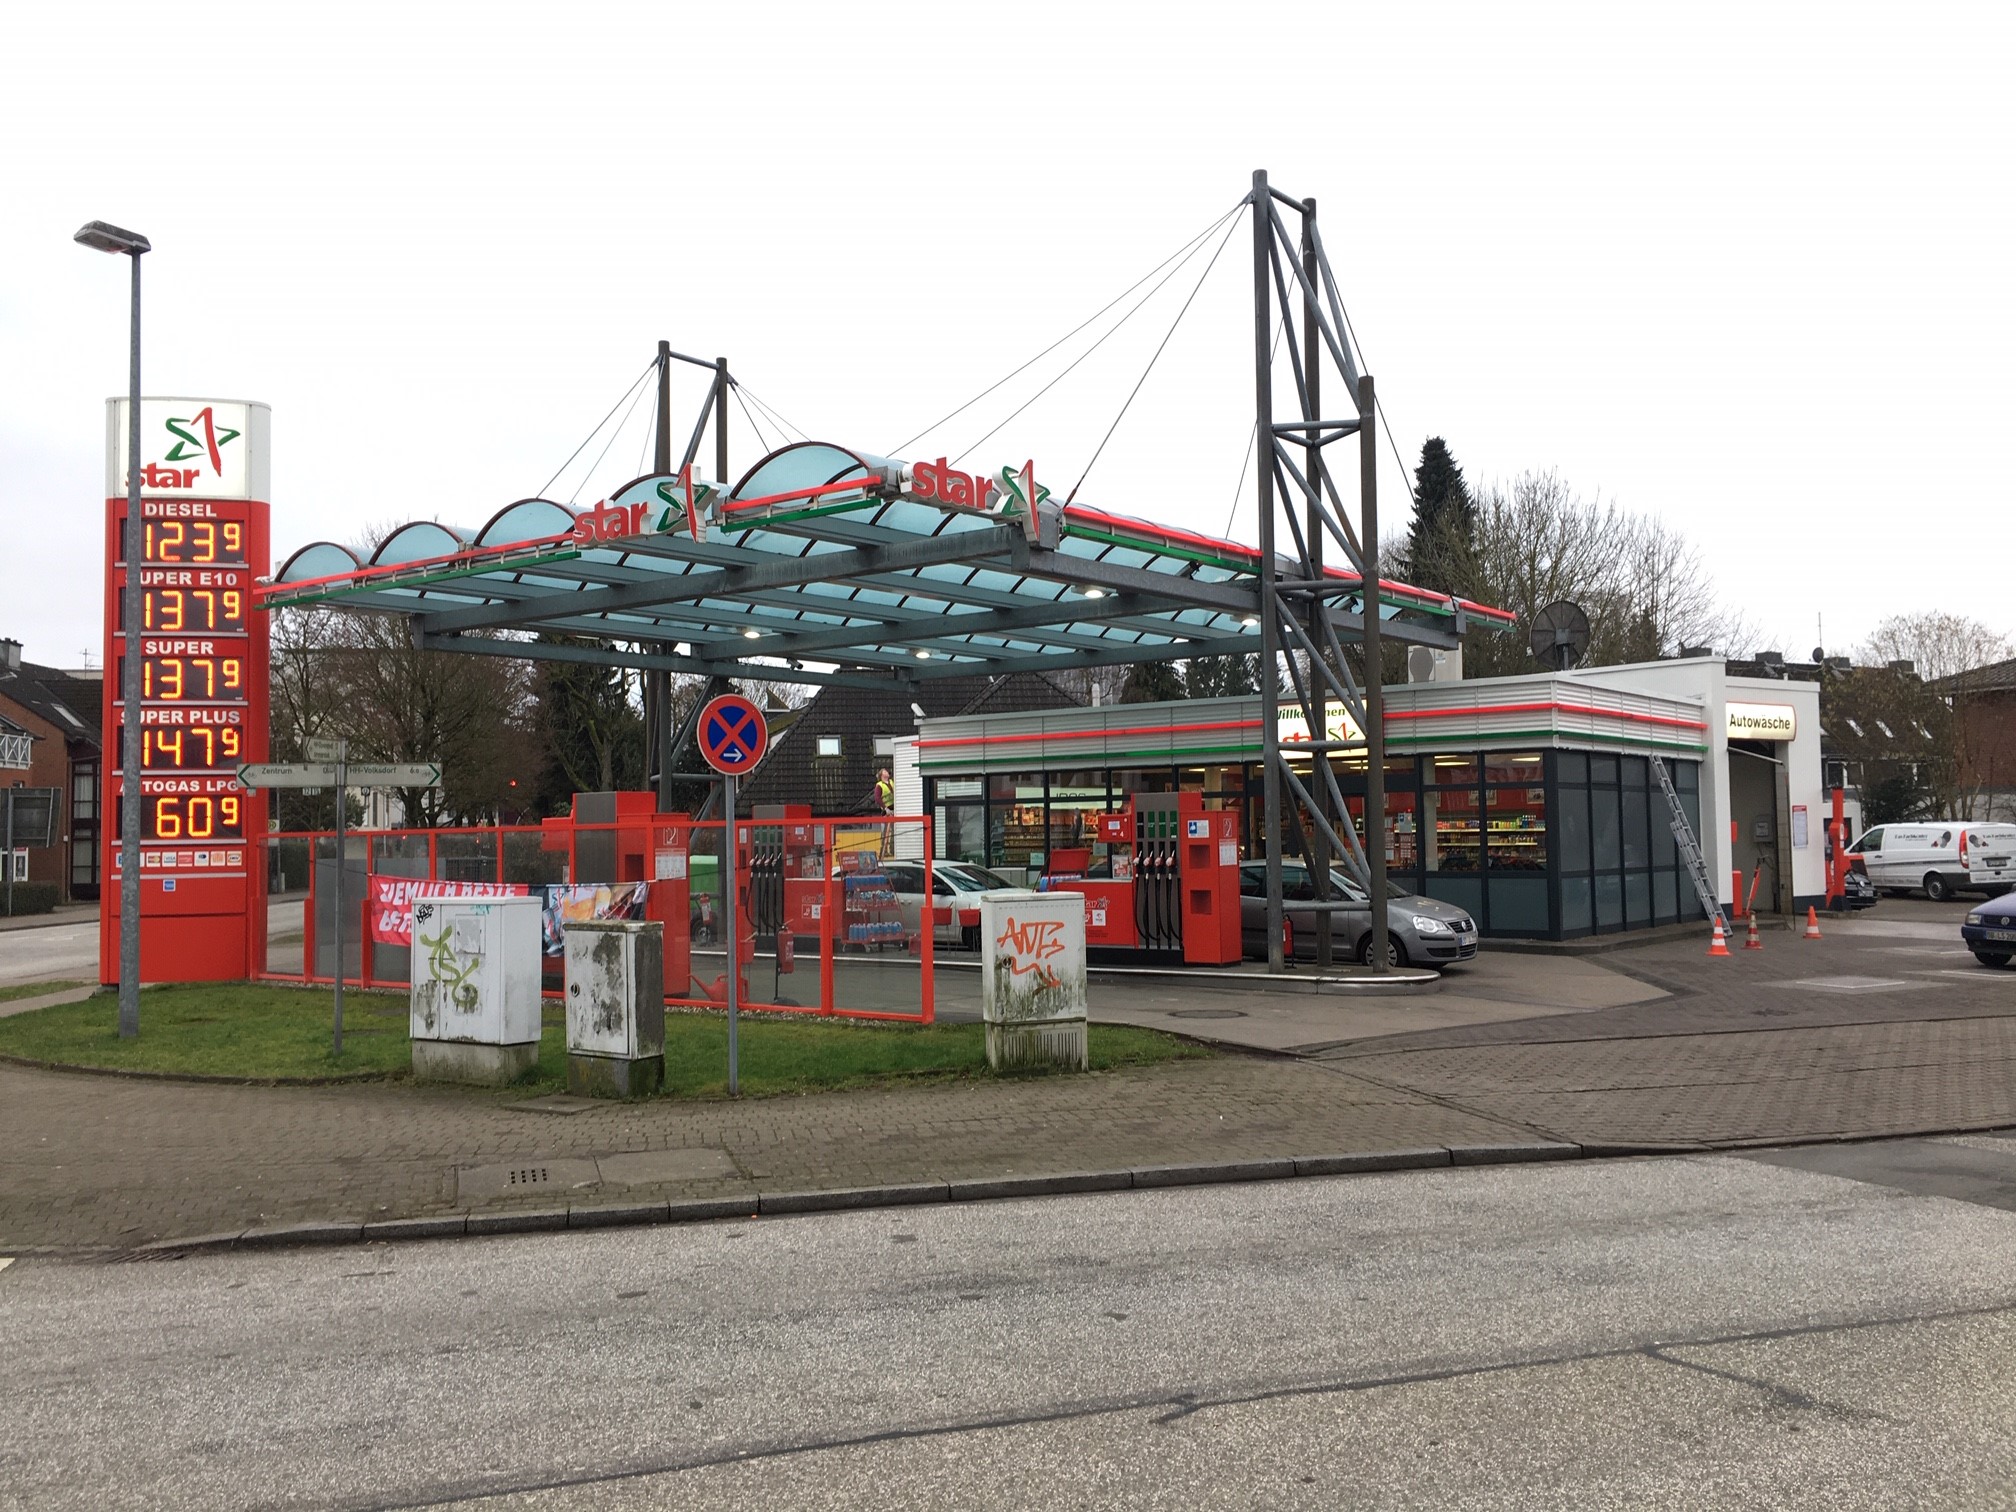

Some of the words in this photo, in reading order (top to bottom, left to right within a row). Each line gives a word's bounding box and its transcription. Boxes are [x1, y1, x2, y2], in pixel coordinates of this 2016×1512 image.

[912, 456, 993, 510] star
[145, 503, 217, 517] DIESEL
[572, 499, 649, 545] star
[146, 521, 240, 562] 1239
[125, 572, 192, 585] UPER
[200, 572, 237, 585] E10
[145, 590, 239, 629] 1379
[145, 641, 214, 655] SUPER
[144, 659, 239, 698] 1379
[190, 710, 240, 724] PLUS
[1729, 713, 1791, 730] Autowäsche
[143, 728, 238, 766] 1479
[262, 767, 293, 775] Zentrum
[349, 766, 397, 774] HH-Volksdorf
[120, 780, 200, 793] TOGAS
[206, 780, 239, 793] LPG
[156, 797, 237, 837] 609
